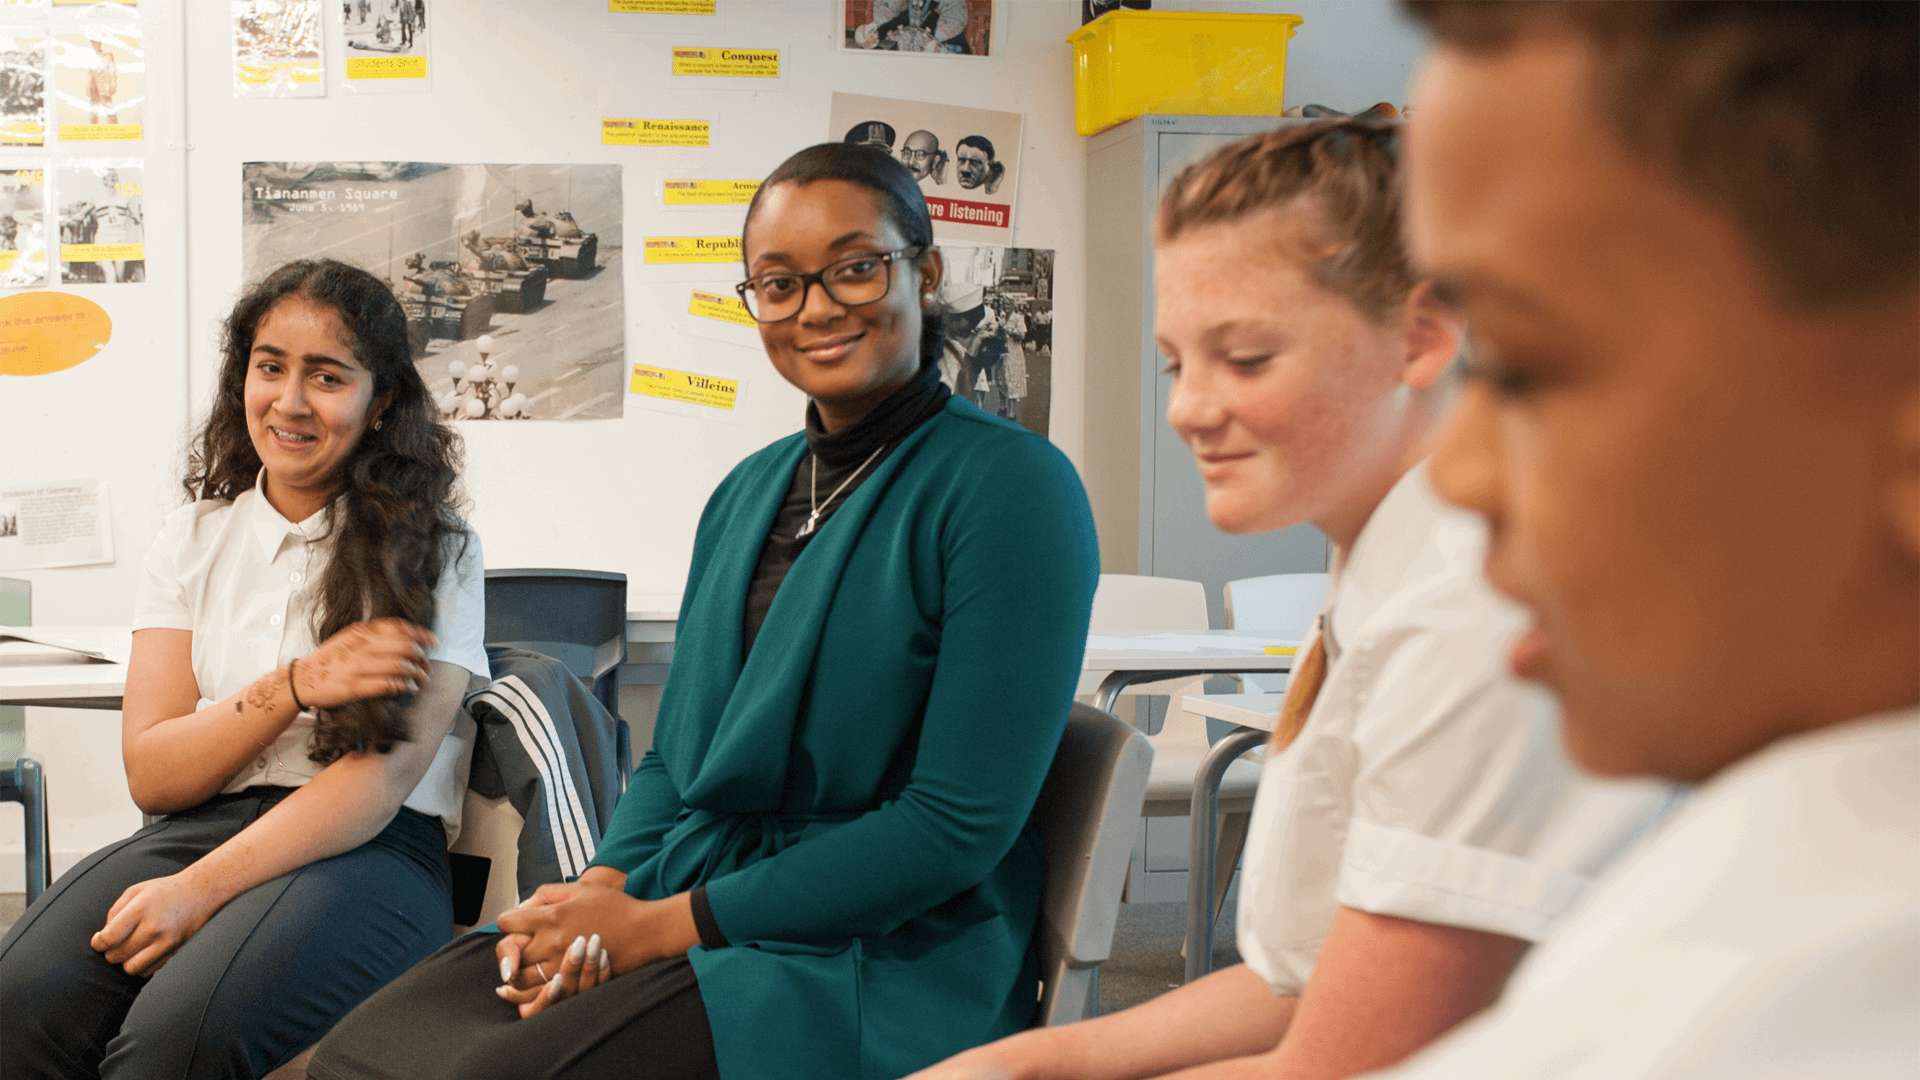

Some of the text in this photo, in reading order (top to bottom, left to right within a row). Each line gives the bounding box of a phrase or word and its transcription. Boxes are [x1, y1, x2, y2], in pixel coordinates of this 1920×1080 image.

[722, 50, 778, 63] Conquest
[644, 121, 709, 132] Renaissance
[255, 187, 398, 202] Tiananmen Square
[289, 203, 315, 213] June
[949, 202, 1004, 226] listening
[687, 375, 735, 394] Villeins
[3, 486, 82, 498] Invasion of Germany
